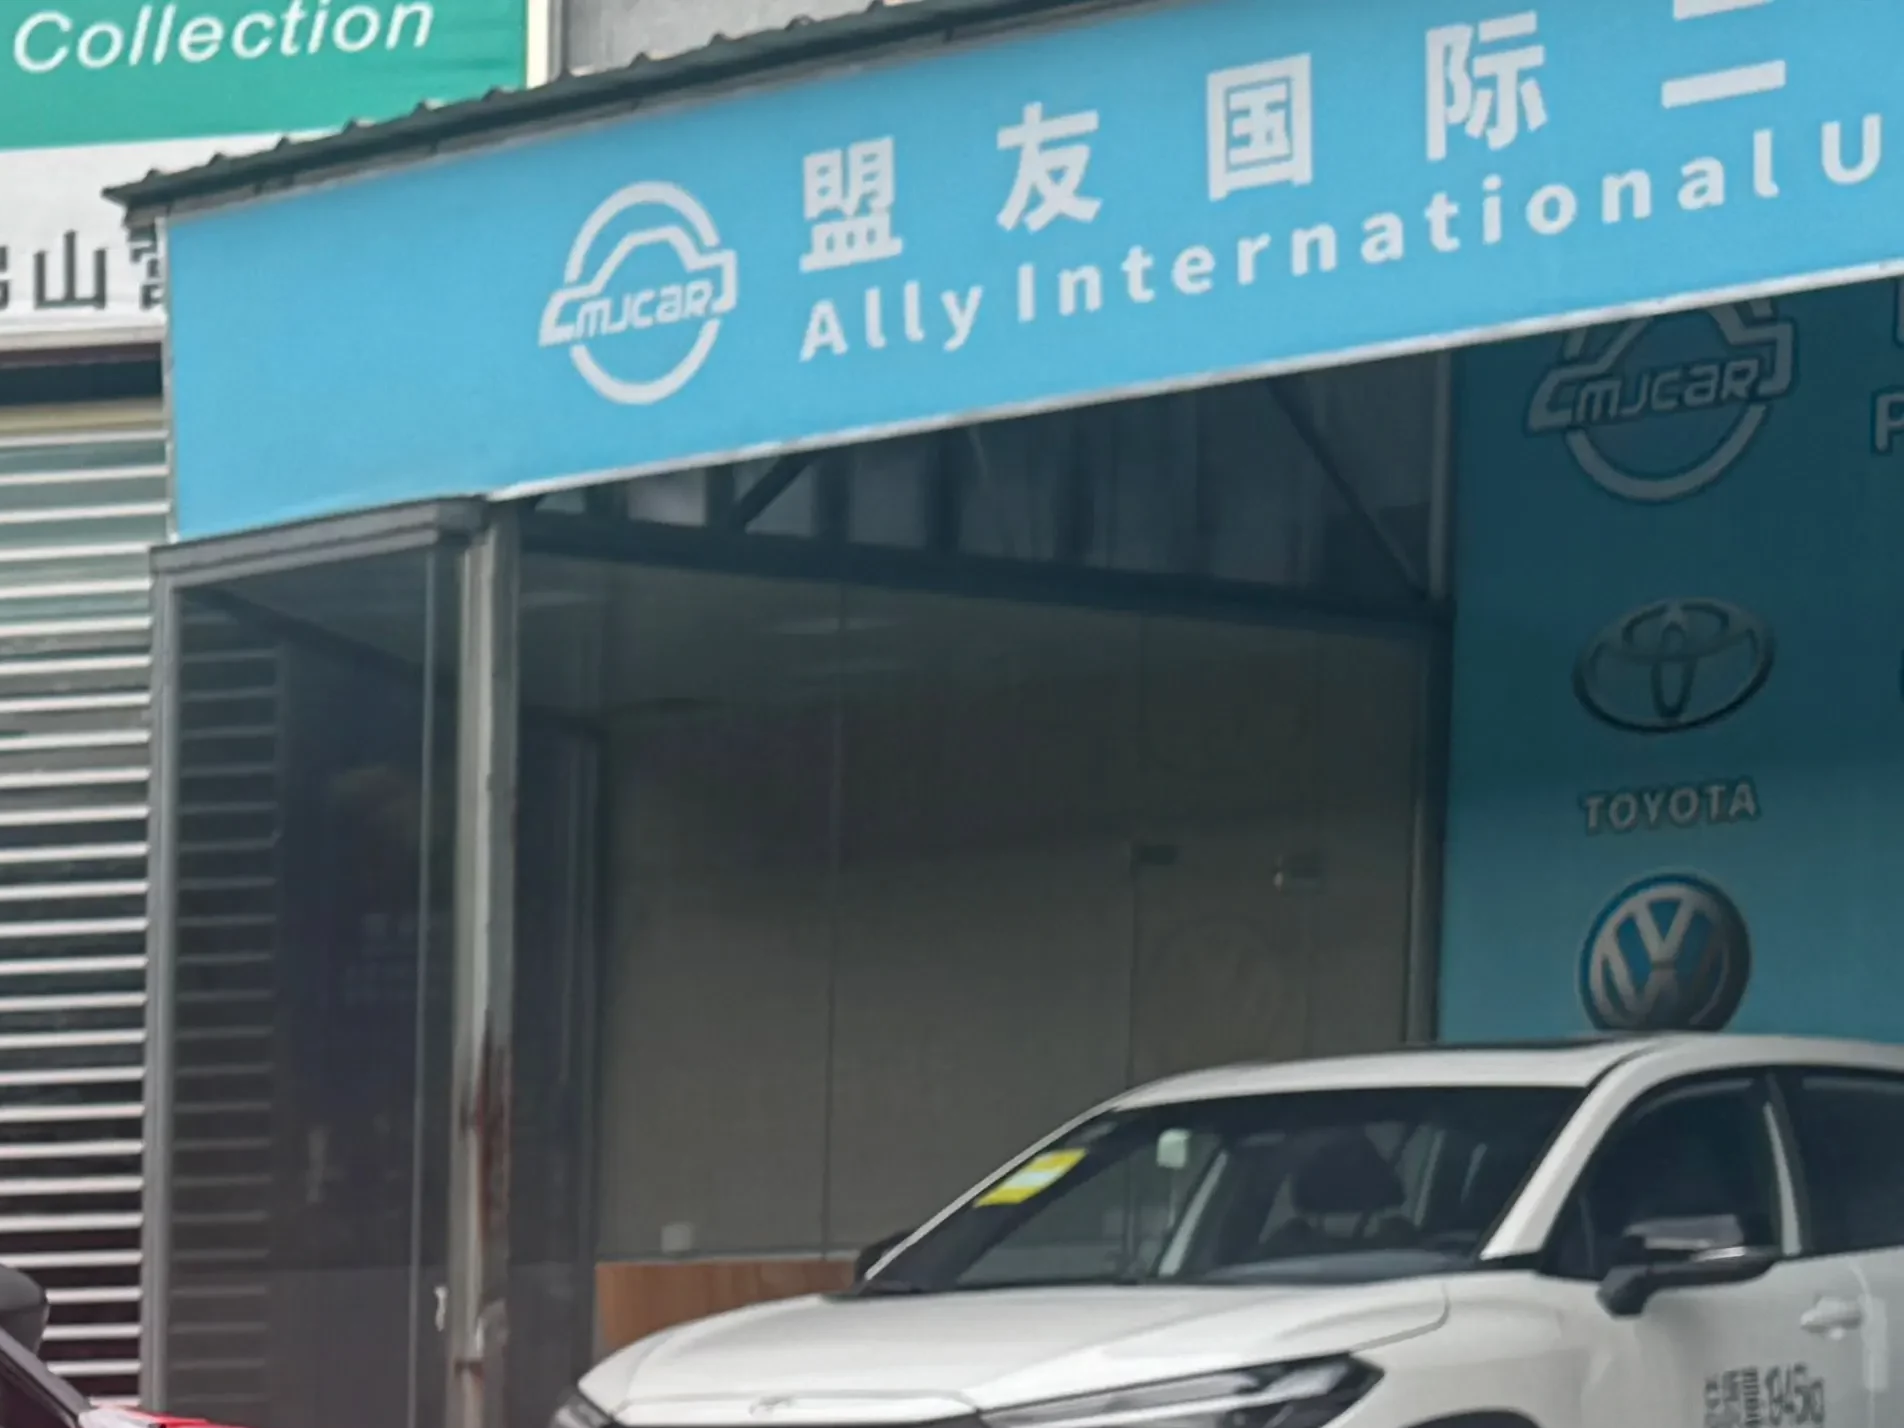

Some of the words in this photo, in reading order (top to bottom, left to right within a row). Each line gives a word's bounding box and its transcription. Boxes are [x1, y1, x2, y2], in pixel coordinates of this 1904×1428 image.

[11, 0, 433, 74] Collection
[799, 282, 984, 363] Ally
[1016, 128, 1780, 323] International
[1583, 781, 1760, 832] TOYOTA
